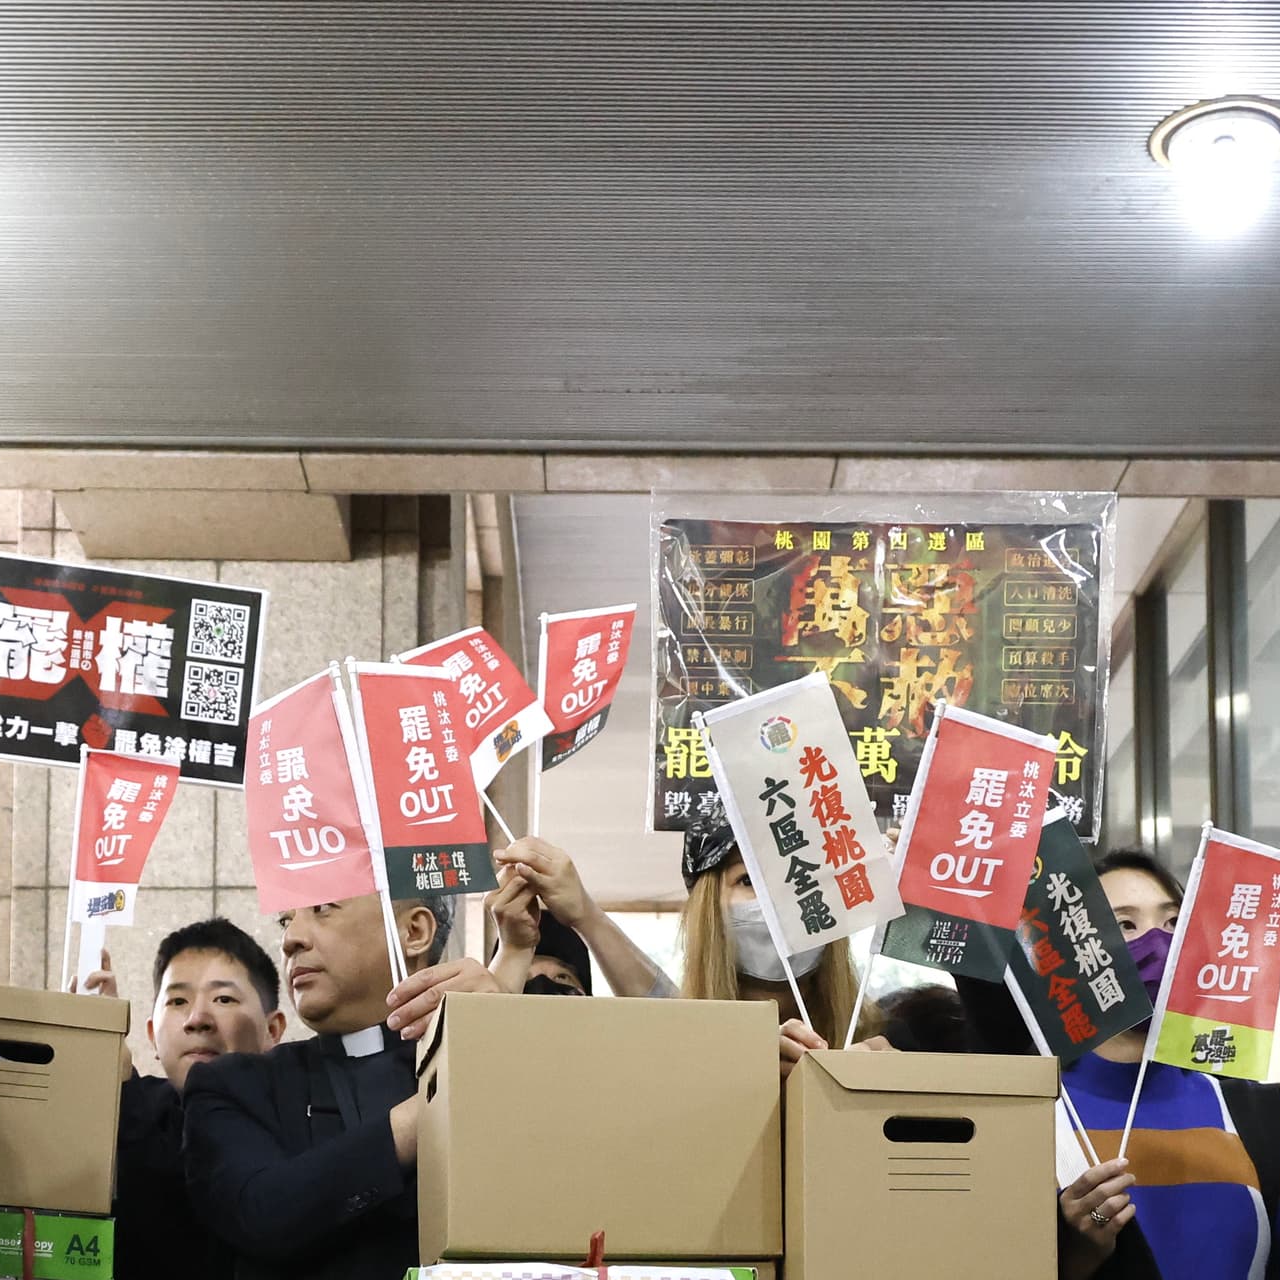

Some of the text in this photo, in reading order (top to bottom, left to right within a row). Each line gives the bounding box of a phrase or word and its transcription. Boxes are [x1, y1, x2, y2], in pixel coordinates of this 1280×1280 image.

[774, 530, 985, 552] 桃園第四選區
[96, 616, 174, 699] 權
[572, 632, 602, 687] 罷免
[606, 620, 624, 664] 桃汰立委
[442, 650, 487, 705] 罷免
[561, 679, 609, 714] OUT
[432, 690, 460, 763] 桃汰立委
[464, 682, 505, 729] OUT
[398, 704, 439, 785] 罷免
[102, 778, 142, 831] 罷免
[137, 775, 168, 823] 桃汰立委
[399, 784, 454, 819] OUT
[954, 767, 1008, 850] 罷免
[1009, 760, 1040, 839] 桃汰立委
[95, 834, 132, 859] OUT
[799, 746, 875, 911] 光復桃園
[759, 777, 837, 936] 六區全罷
[929, 853, 1003, 886] OUT
[1045, 872, 1126, 1012] 光復桃園
[1218, 883, 1262, 959] 罷免
[1197, 964, 1260, 991] OUT
[65, 1234, 101, 1257] A4
